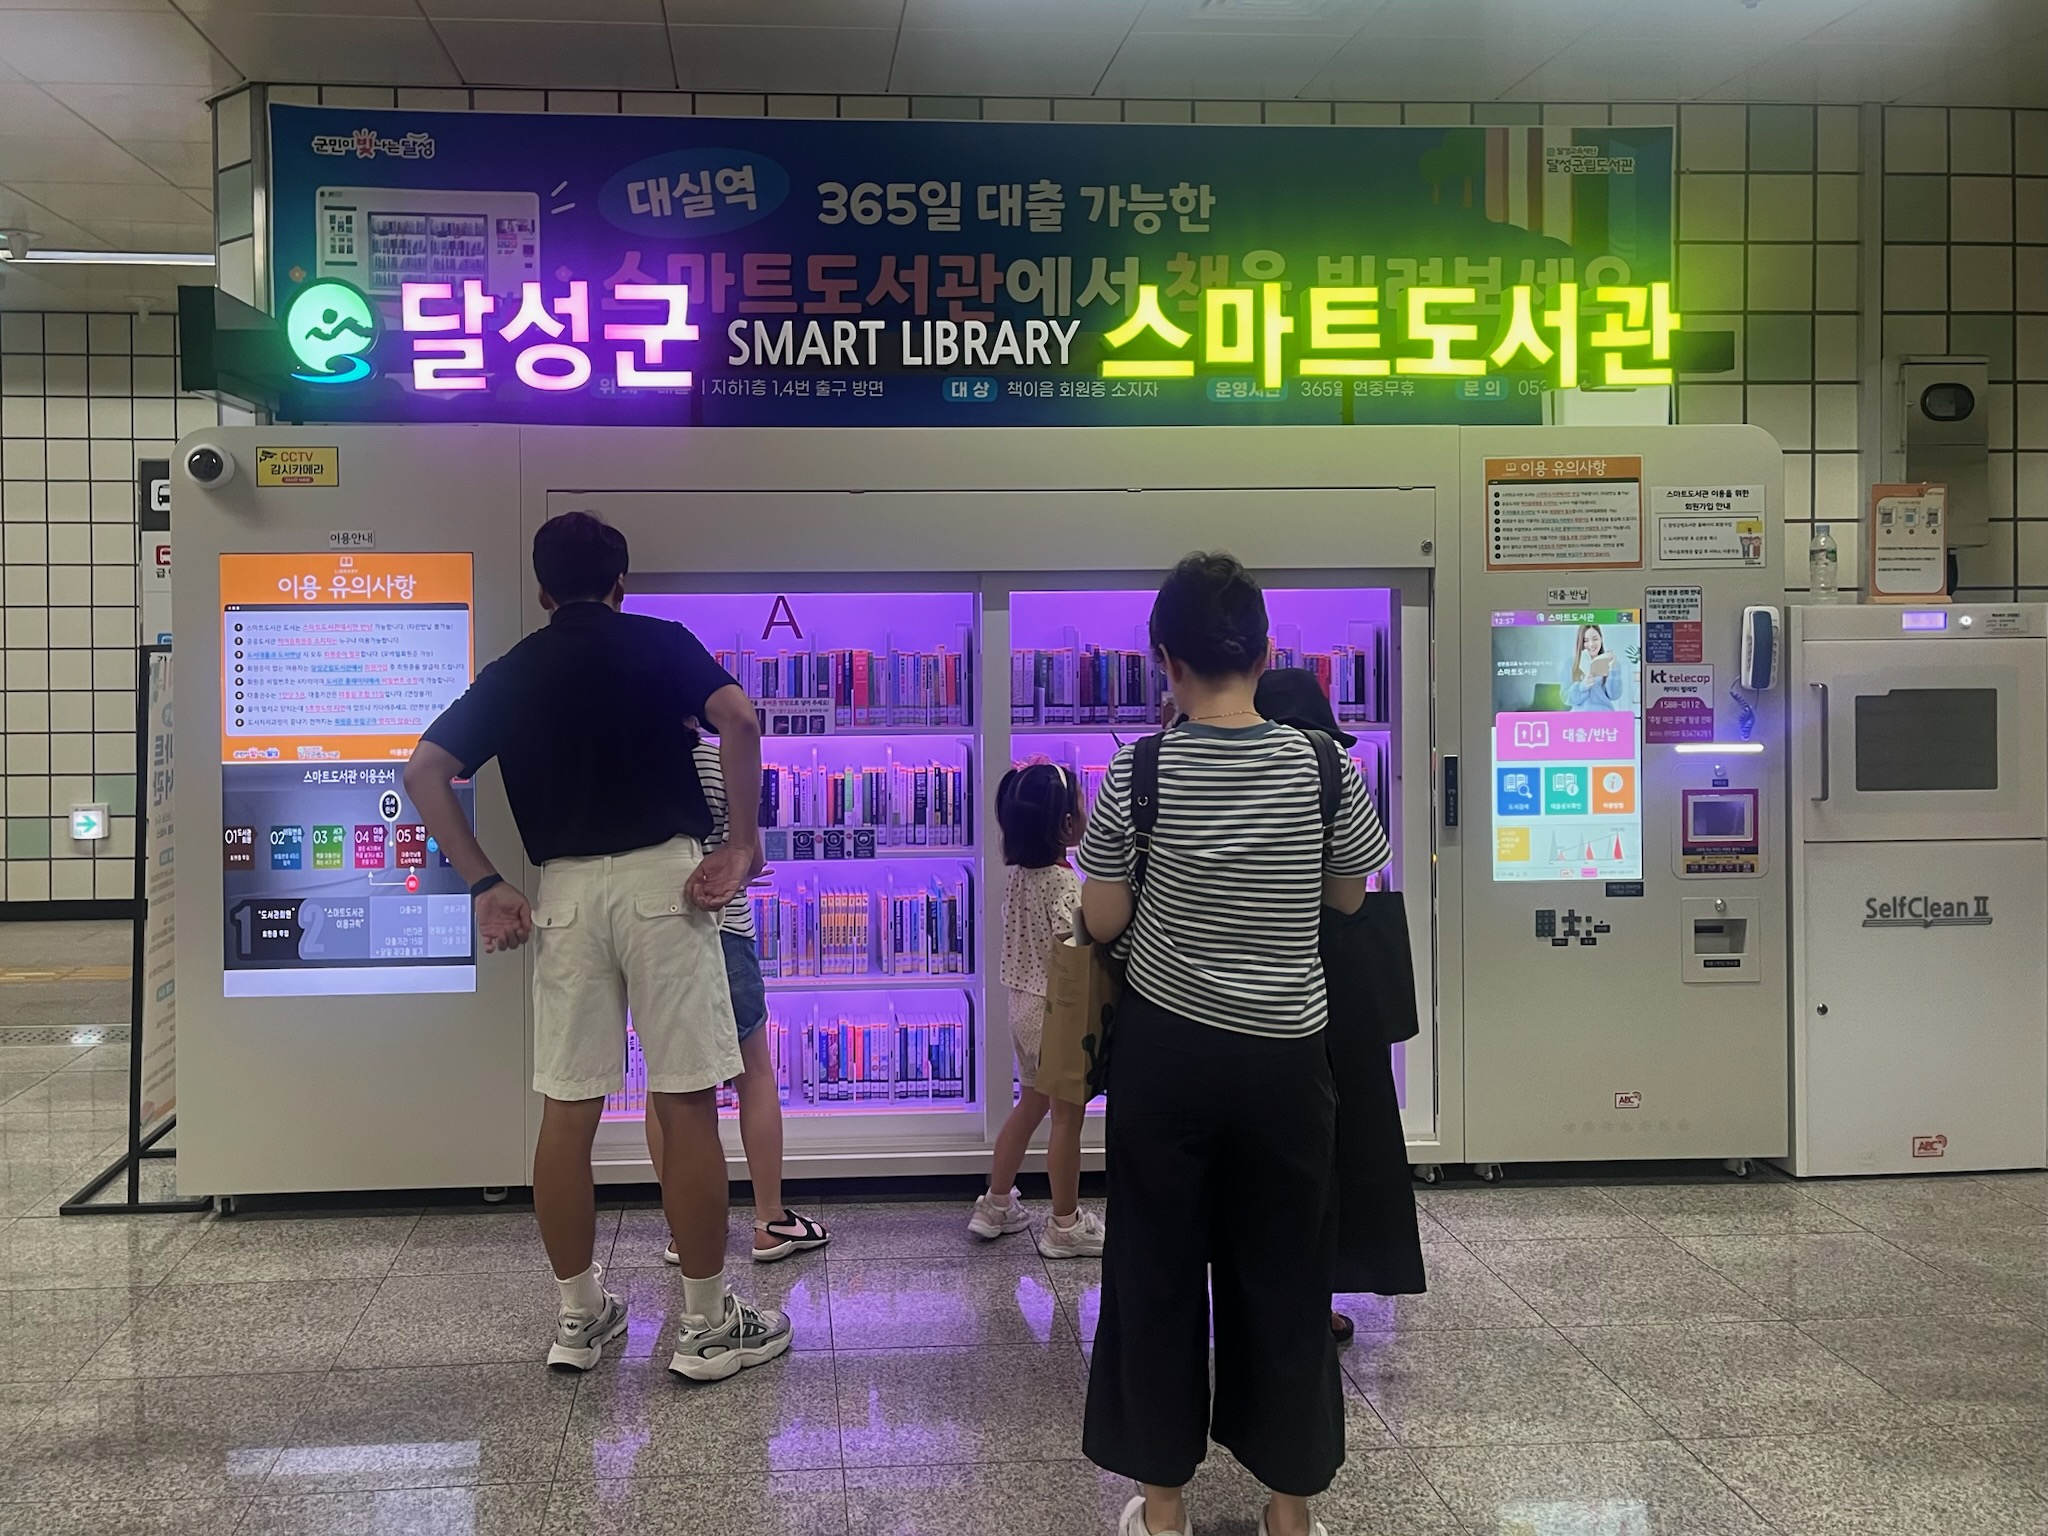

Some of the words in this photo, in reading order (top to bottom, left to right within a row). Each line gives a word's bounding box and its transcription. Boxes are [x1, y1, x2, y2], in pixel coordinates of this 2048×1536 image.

[1546, 158, 1634, 173] 달성군립도서관
[627, 165, 758, 219] 대실역
[817, 182, 962, 231] 365일
[976, 183, 1066, 232] 대출
[1080, 182, 1216, 233] 가능한
[400, 279, 700, 391] 달성군
[1099, 281, 1682, 390] 스마트도서관
[727, 319, 886, 368] SMART
[900, 319, 1081, 366] LIBRARY
[711, 378, 767, 396] 지하1층
[772, 379, 810, 397] 1,4번
[815, 379, 848, 397] 출구
[852, 379, 884, 397] 방면
[1007, 381, 1054, 398] 책이음
[1059, 381, 1106, 398] 회원증
[1111, 381, 1159, 398] 소지자
[1353, 380, 1415, 397] 연중무휴
[280, 451, 314, 462] CCTV
[270, 464, 324, 475] 감시카메라
[1520, 461, 1548, 477] 이용
[1552, 460, 1607, 477] 유의사항
[1666, 490, 1708, 498] 스마트도서관
[1710, 490, 1732, 498] 이용을
[1734, 490, 1750, 498] 위한
[1684, 502, 1714, 511] 회원가입
[1716, 502, 1732, 511] 안내
[330, 532, 374, 545] 이용안내
[278, 574, 322, 600] 이용
[328, 573, 417, 600] 유의사항
[761, 595, 804, 640] A
[1548, 612, 1595, 623] 스마트도서관
[1496, 668, 1538, 677] 스마트도서관
[1650, 669, 1667, 683] kt
[1669, 673, 1710, 685] telecop
[1660, 700, 1701, 709] 1588-0112
[1562, 727, 1619, 743] 대출/반납
[303, 770, 358, 784] 스마트도서관
[359, 769, 395, 784] 이용순서
[225, 829, 238, 844] 01
[270, 831, 285, 845] 02
[313, 830, 328, 844] 03
[355, 830, 370, 843] 04
[397, 829, 412, 843] 05
[1866, 896, 1969, 919] SelfClean
[1619, 1096, 1635, 1105] ABC
[1918, 1141, 1938, 1151] ABC
